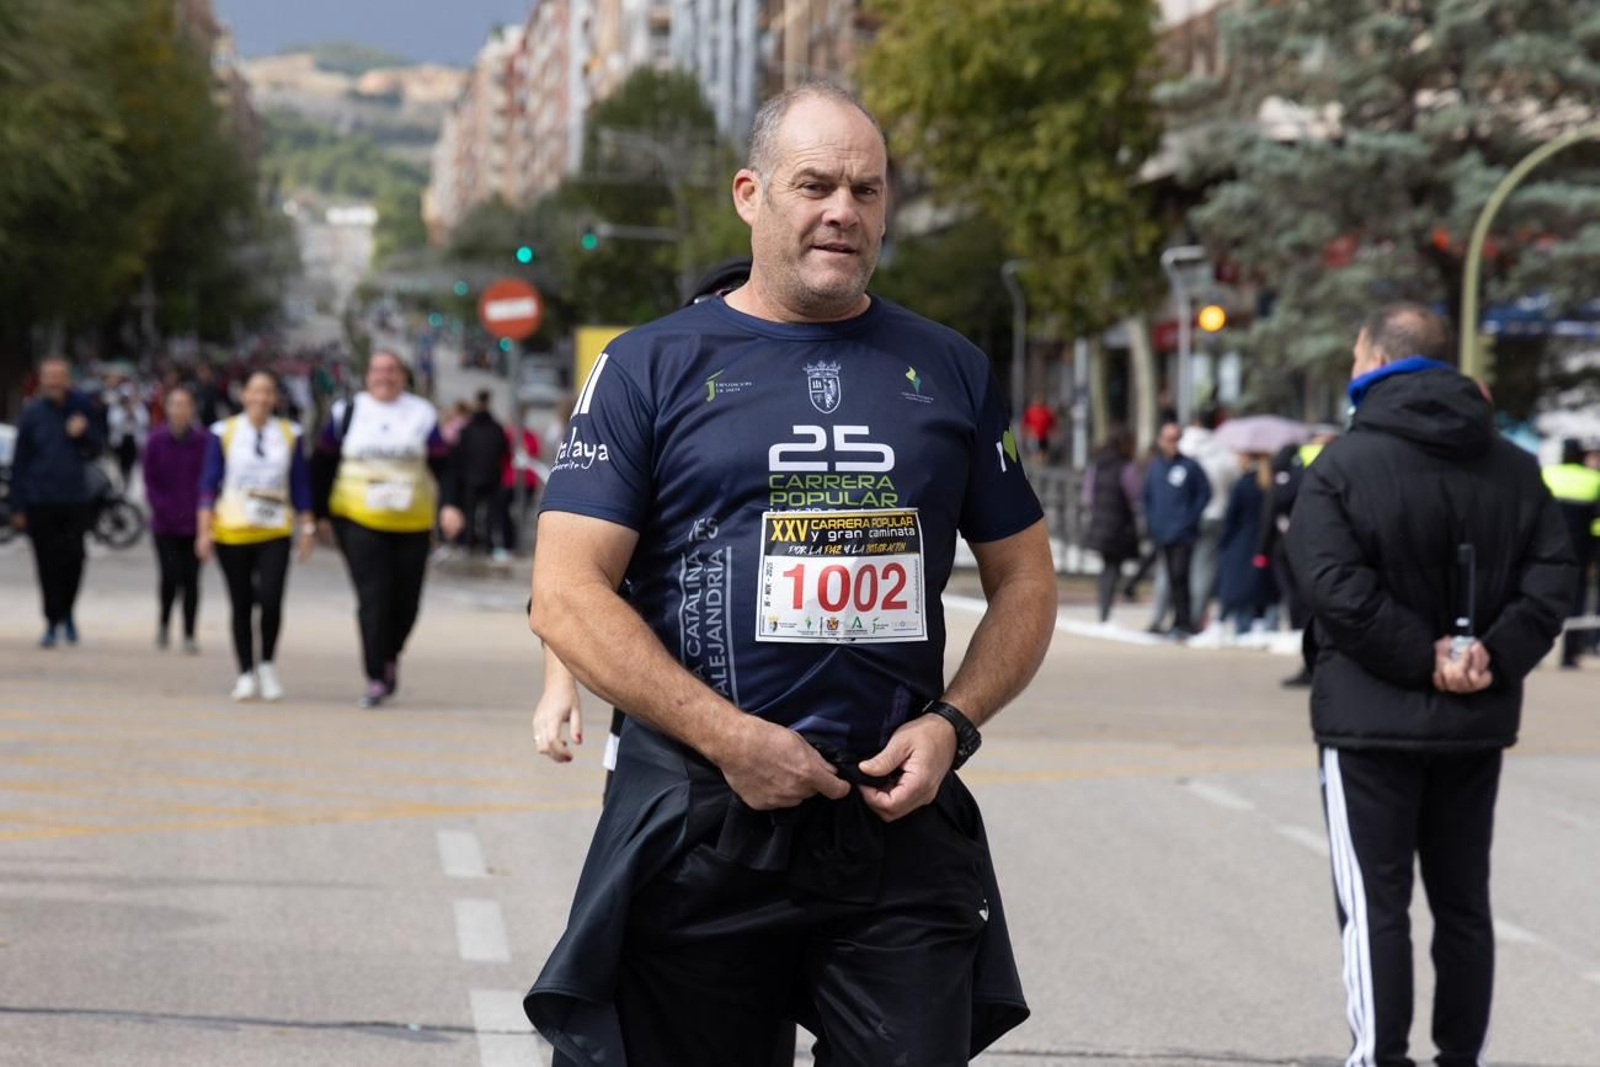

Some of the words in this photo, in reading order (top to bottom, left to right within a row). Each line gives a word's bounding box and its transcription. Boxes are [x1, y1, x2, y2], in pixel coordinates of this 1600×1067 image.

[769, 425, 895, 472] 25
[769, 474, 895, 490] CARRERA
[770, 491, 898, 508] POPULAR
[688, 517, 719, 542] IES
[771, 519, 809, 542] XXV
[811, 518, 870, 530] CARRERA
[872, 516, 914, 528] POPULAR
[811, 531, 819, 542] y
[827, 529, 863, 542] gran
[869, 527, 916, 538] caminata
[788, 545, 808, 555] POR
[808, 545, 823, 555] LA
[824, 544, 842, 555] PAZ
[851, 544, 866, 554] LA
[783, 562, 908, 613] 1002
[685, 550, 703, 657] CATALINA
